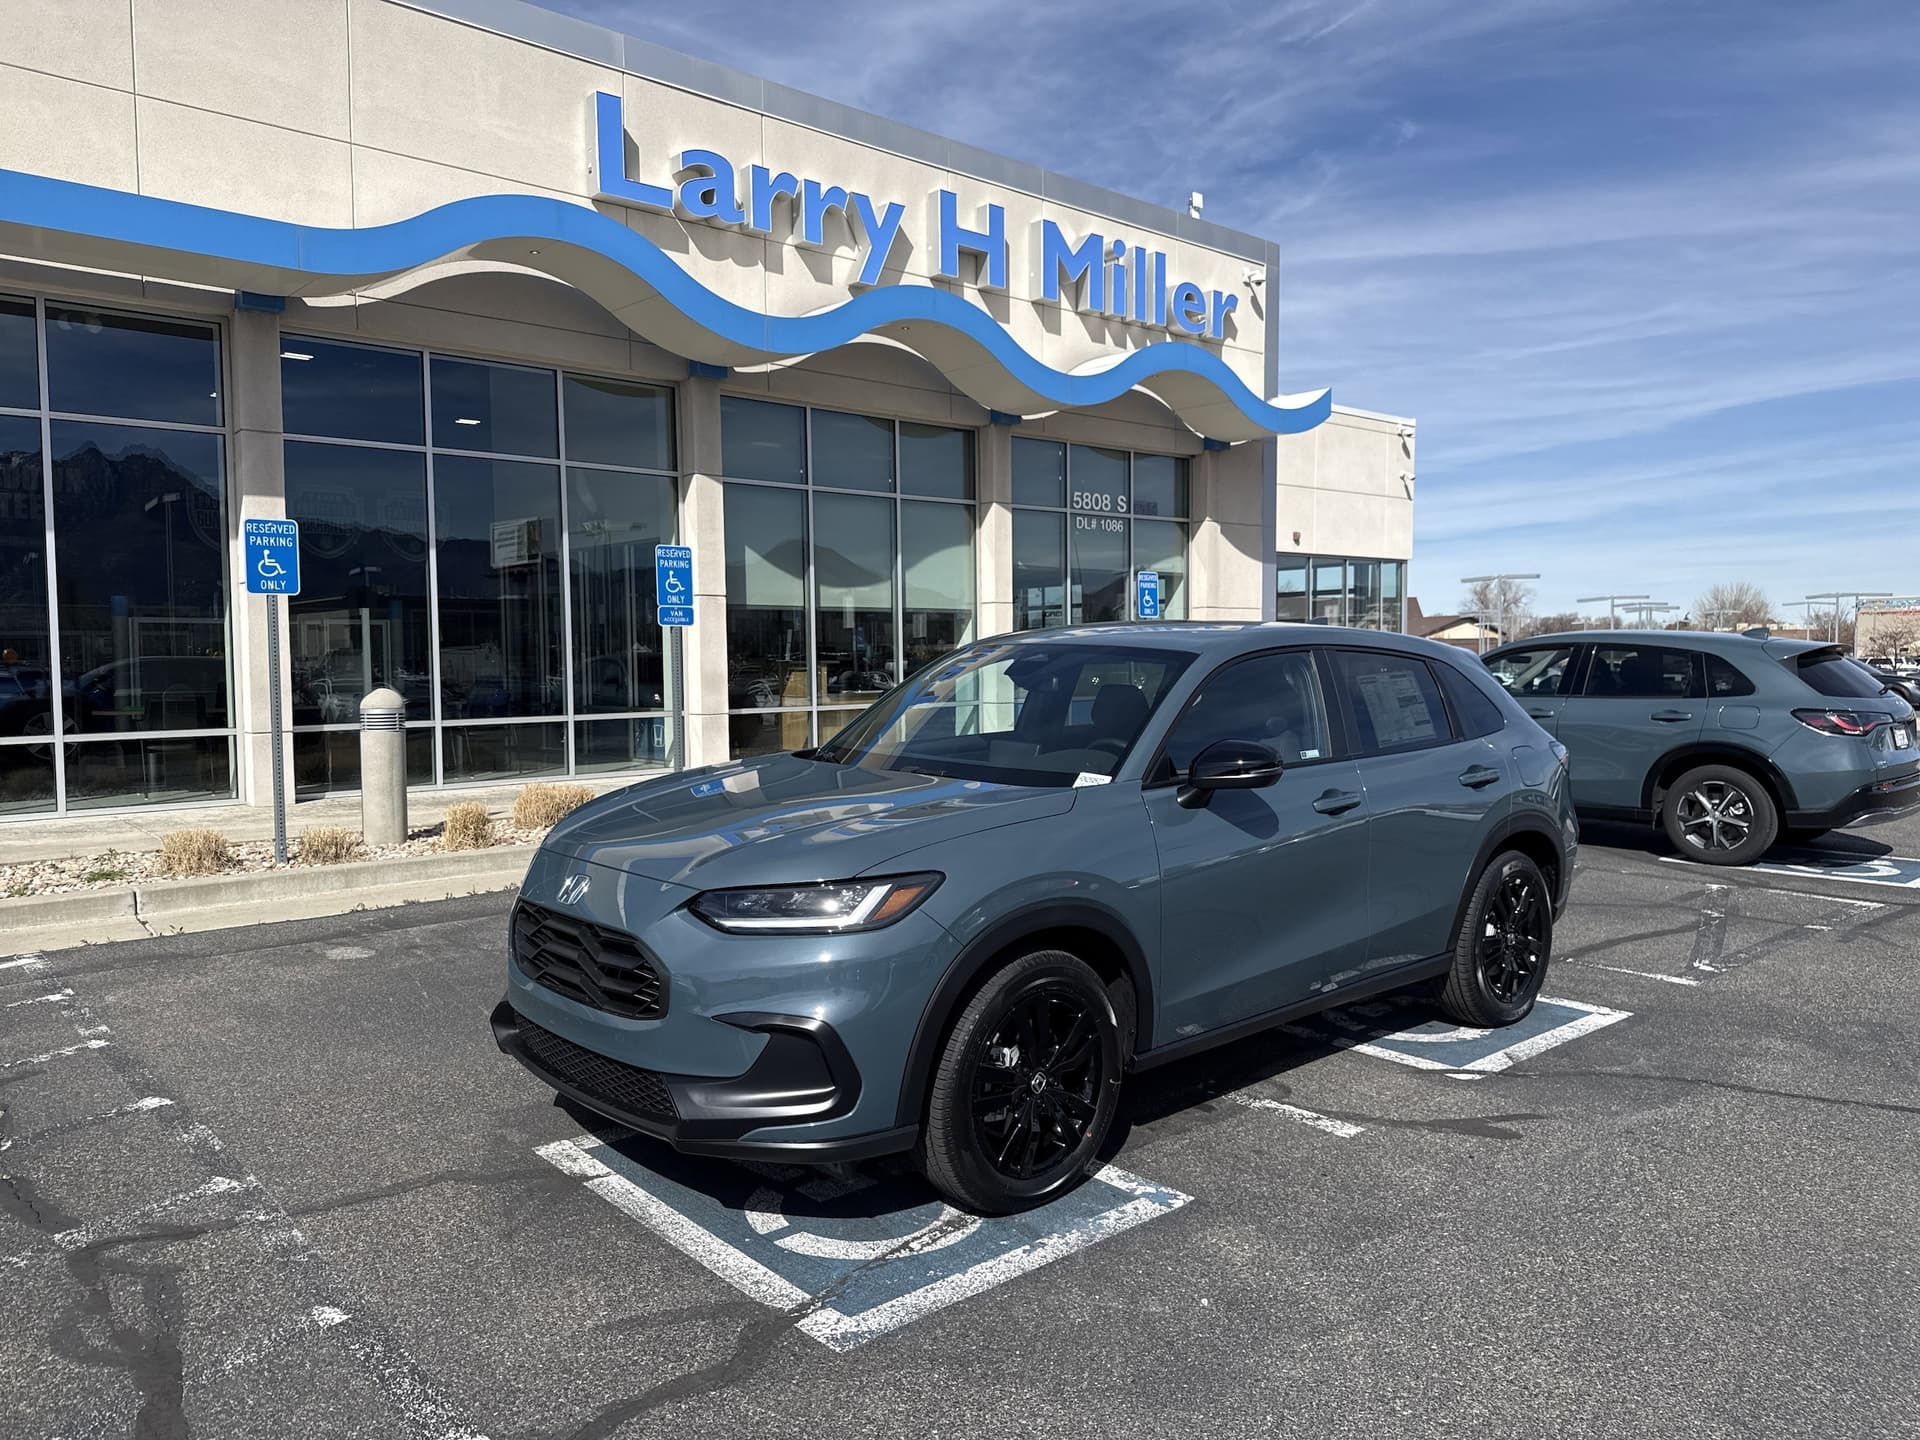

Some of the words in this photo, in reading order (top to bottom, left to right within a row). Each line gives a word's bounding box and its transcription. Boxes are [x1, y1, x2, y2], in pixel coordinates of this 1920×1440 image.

[593, 91, 906, 286] Larry
[930, 189, 1007, 288] H
[1031, 219, 1239, 339] Miller
[1073, 491, 1111, 511] 5808
[1117, 495, 1127, 513] S
[246, 523, 295, 535] RESERVED
[1076, 516, 1097, 530] DL#
[1100, 519, 1124, 533] 1086
[249, 536, 293, 547] PARKING
[657, 548, 691, 559] RESERVED
[660, 559, 689, 569] PARKING
[260, 579, 286, 590] ONLY
[667, 595, 685, 605] ONLY
